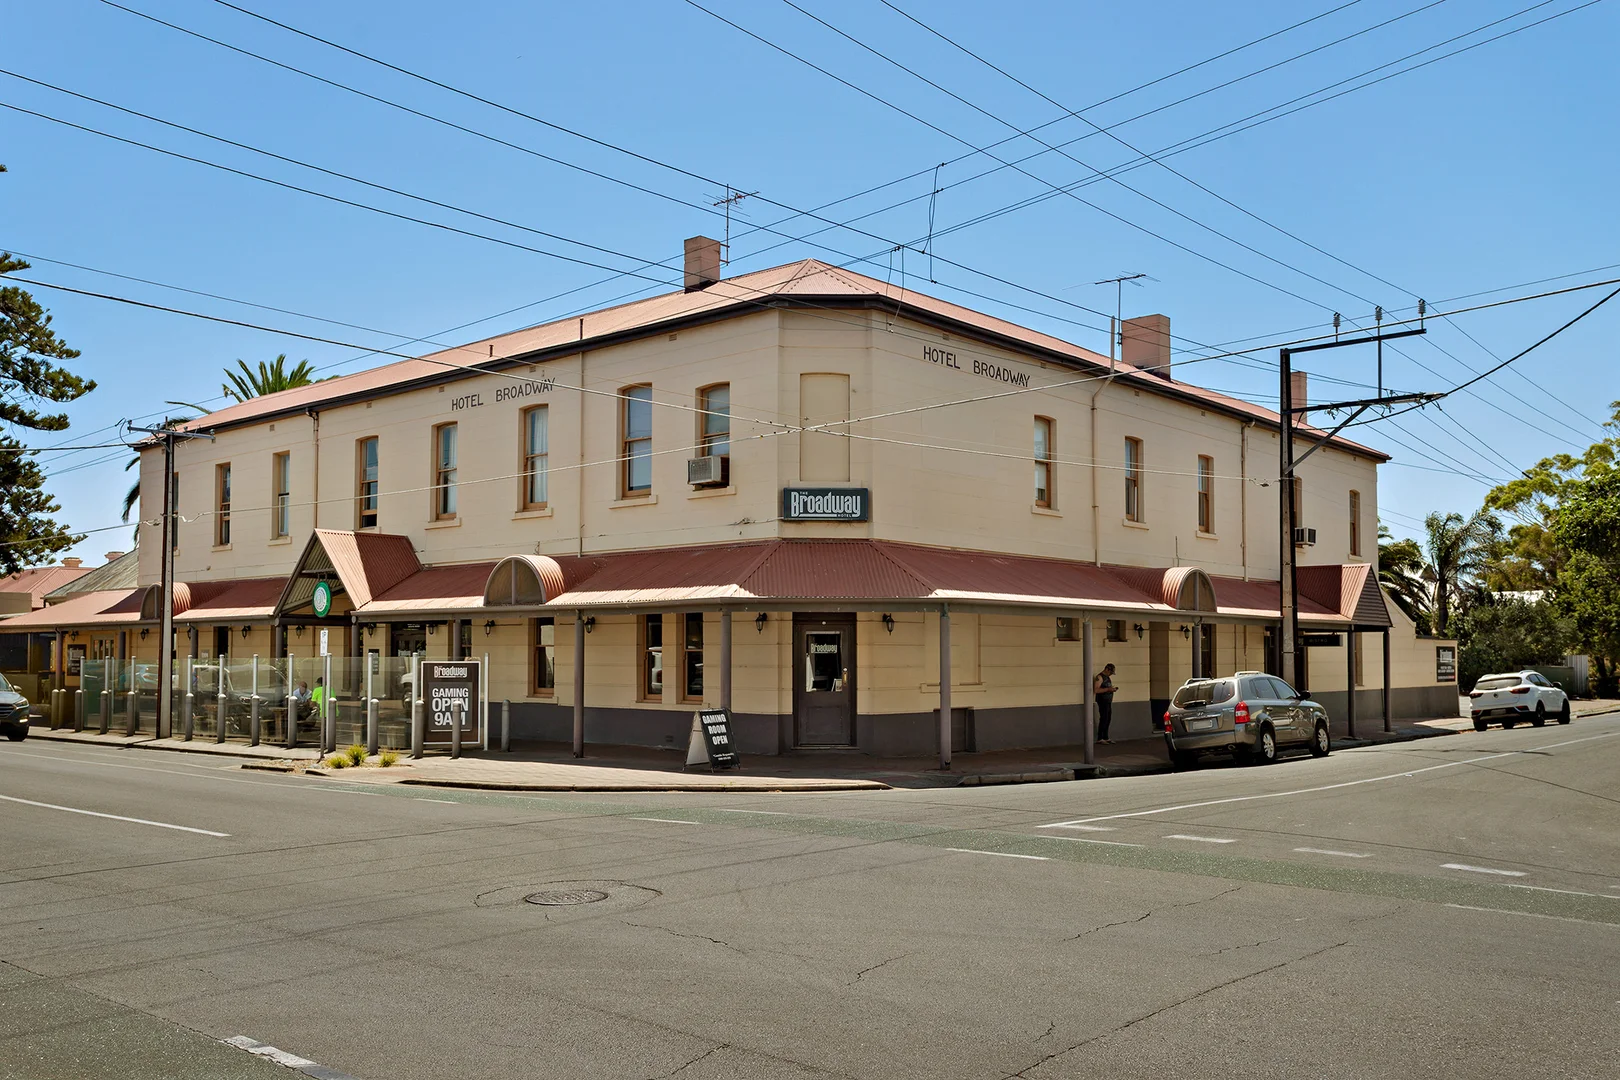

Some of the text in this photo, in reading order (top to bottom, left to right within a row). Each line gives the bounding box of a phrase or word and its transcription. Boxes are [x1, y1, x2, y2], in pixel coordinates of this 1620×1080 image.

[923, 345, 1030, 388] HOTEL BROADWAY
[451, 377, 556, 411] HOTEL BROADWAY
[790, 491, 861, 518] Broadway
[433, 666, 468, 679] Broadway
[432, 688, 469, 698] GAMING
[431, 698, 469, 712] OPEN
[702, 713, 727, 725] GAMING
[707, 724, 727, 735] ROOM
[712, 735, 729, 746] OPEN
